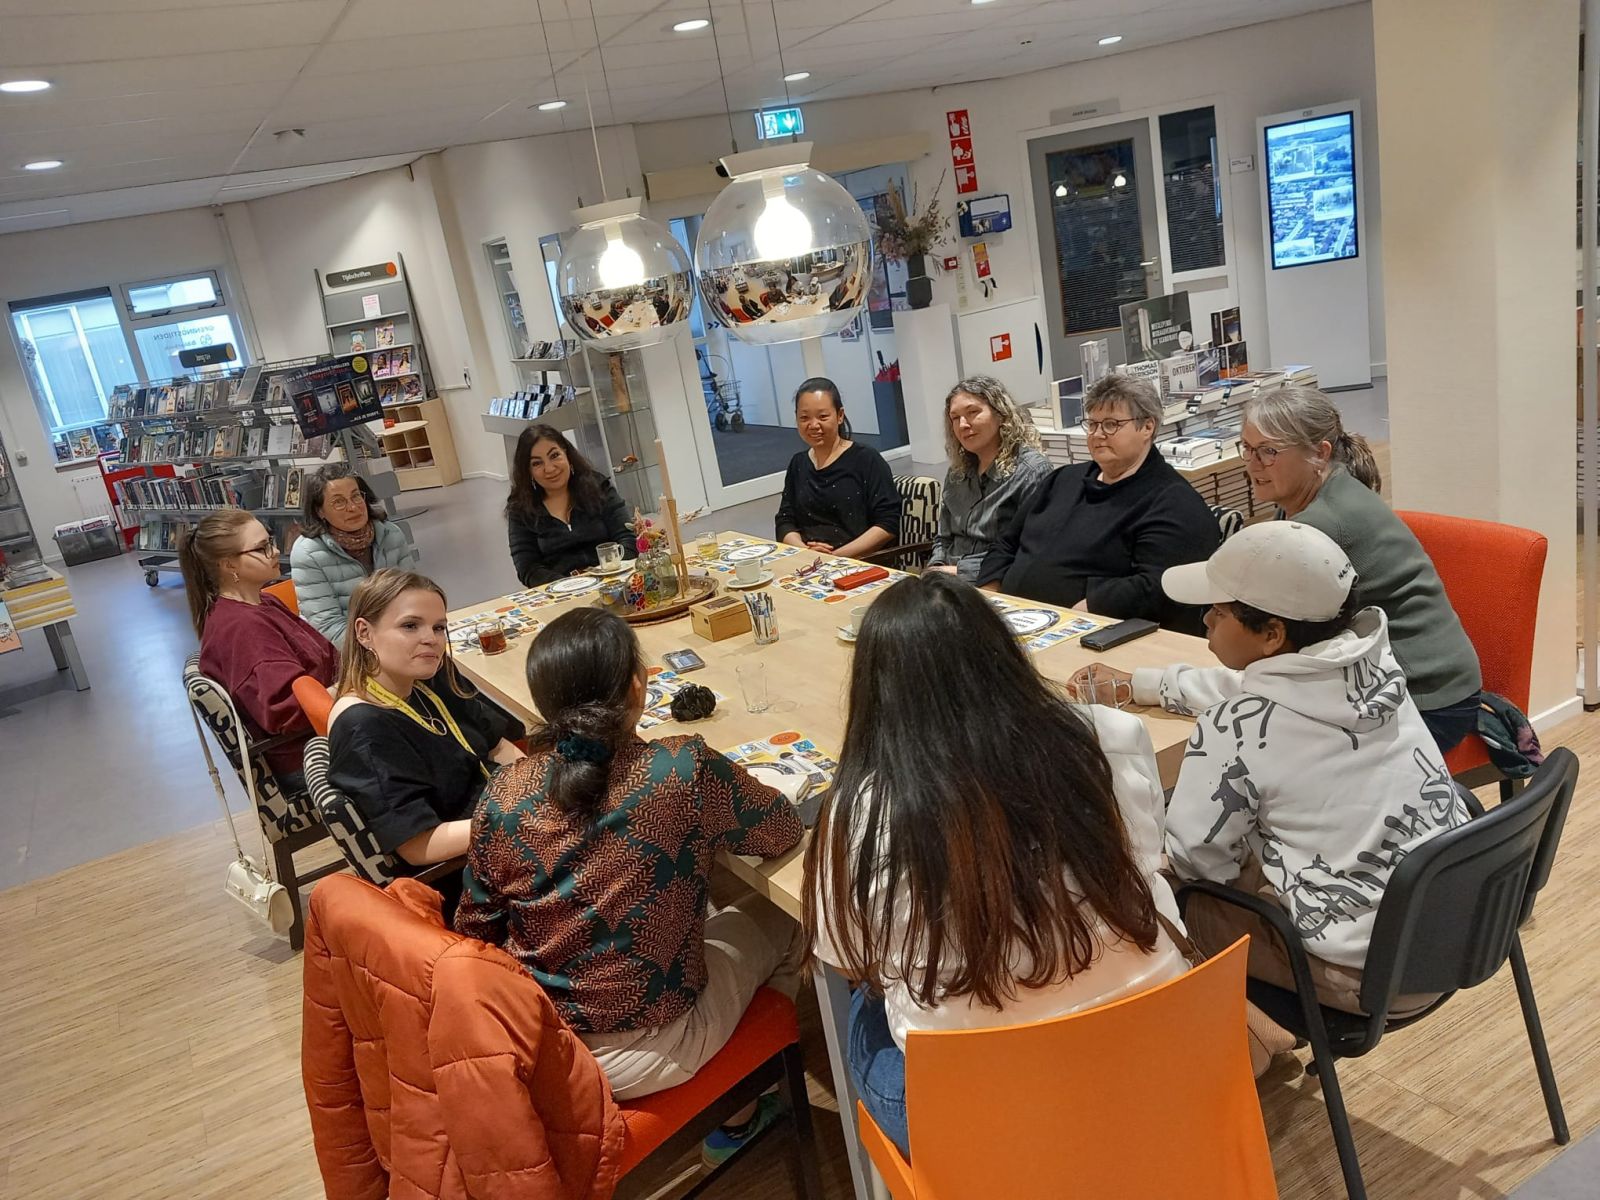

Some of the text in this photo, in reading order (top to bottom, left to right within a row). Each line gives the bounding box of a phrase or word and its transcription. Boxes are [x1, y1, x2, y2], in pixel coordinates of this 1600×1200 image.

[341, 271, 372, 282] Tijdschriften
[1134, 361, 1158, 372] THOMAS
[1172, 362, 1196, 377] OKTOBER
